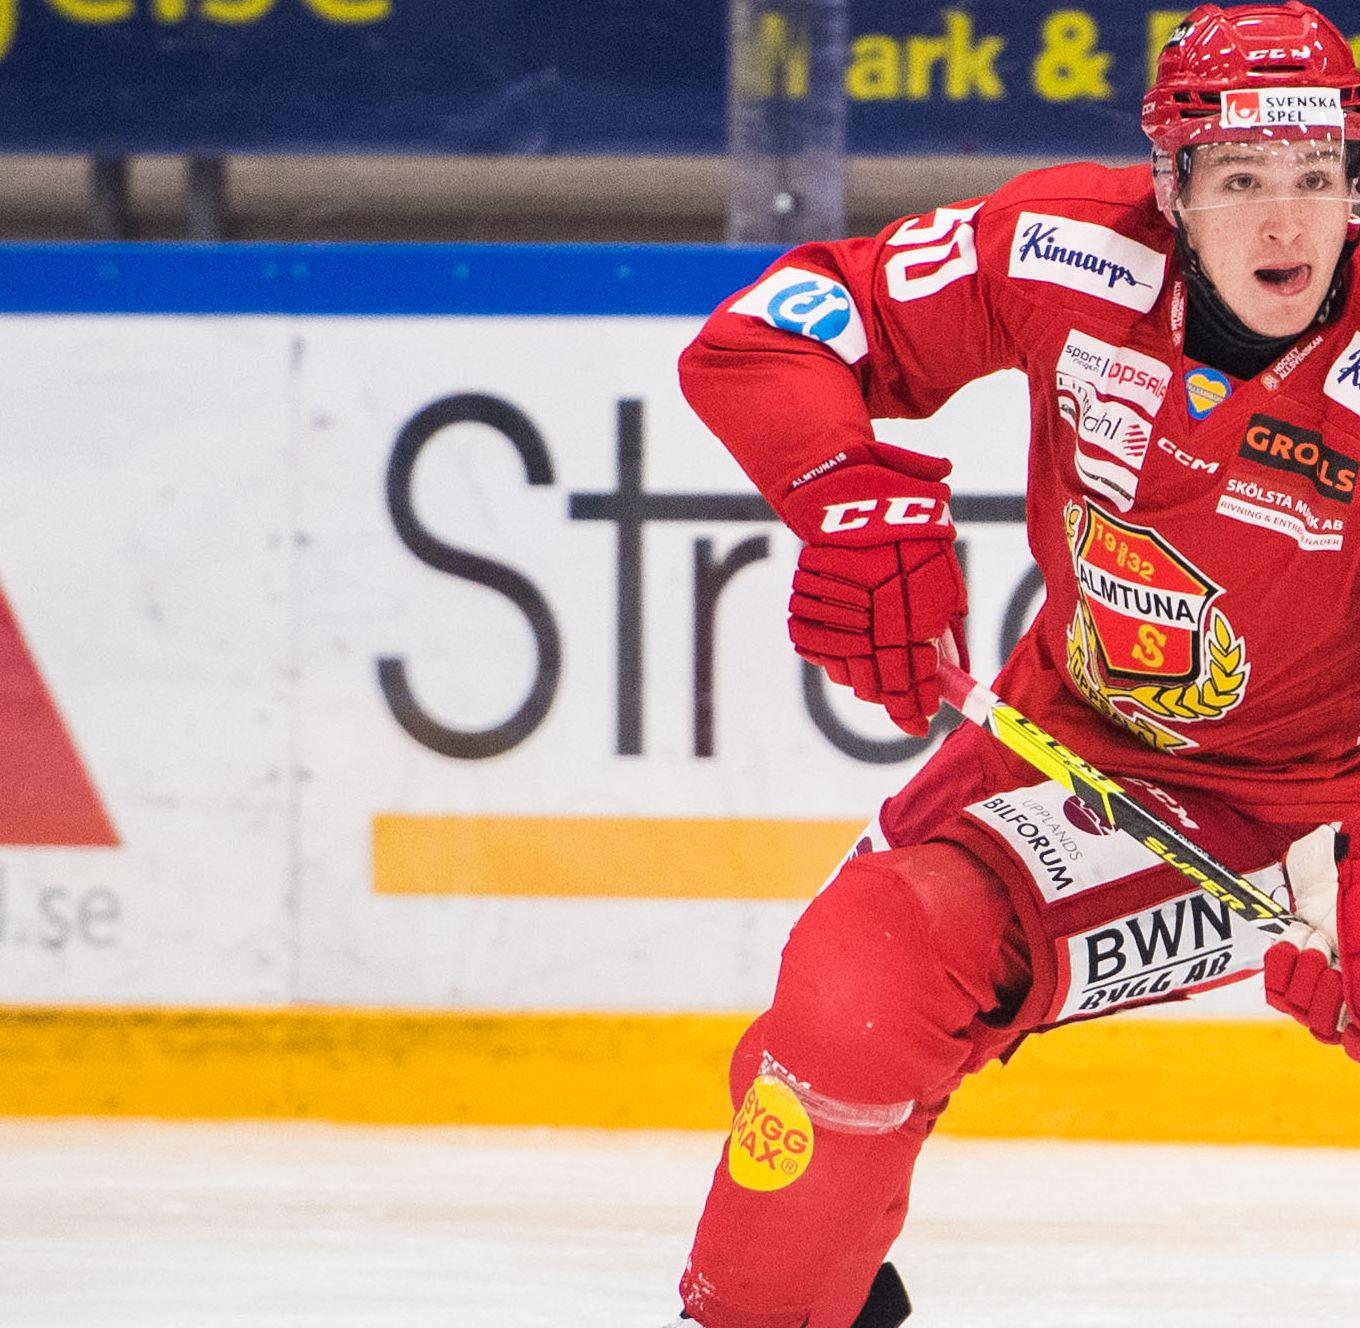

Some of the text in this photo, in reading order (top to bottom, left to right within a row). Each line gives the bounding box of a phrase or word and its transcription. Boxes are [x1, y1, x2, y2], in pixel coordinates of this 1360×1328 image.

[1034, 8, 1113, 101] &
[1266, 96, 1337, 108] SVENSKA
[1267, 110, 1306, 123] SPEL
[1019, 222, 1152, 289] Kinnarps
[1065, 344, 1103, 368] sport
[792, 451, 848, 488] ALMTUNA IS
[1157, 436, 1220, 474] CCM
[1246, 425, 1356, 492] GROLS
[1226, 479, 1293, 509] SKÖLSTA
[1321, 519, 1344, 531] AB
[1080, 563, 1196, 625] ALMTUNA
[982, 798, 1074, 891] BILFORUM
[1022, 799, 1084, 862] UPPLANDS
[1144, 836, 1246, 910] SUPER
[1085, 893, 1233, 984] BWN
[1078, 951, 1232, 1011] BYGG AB
